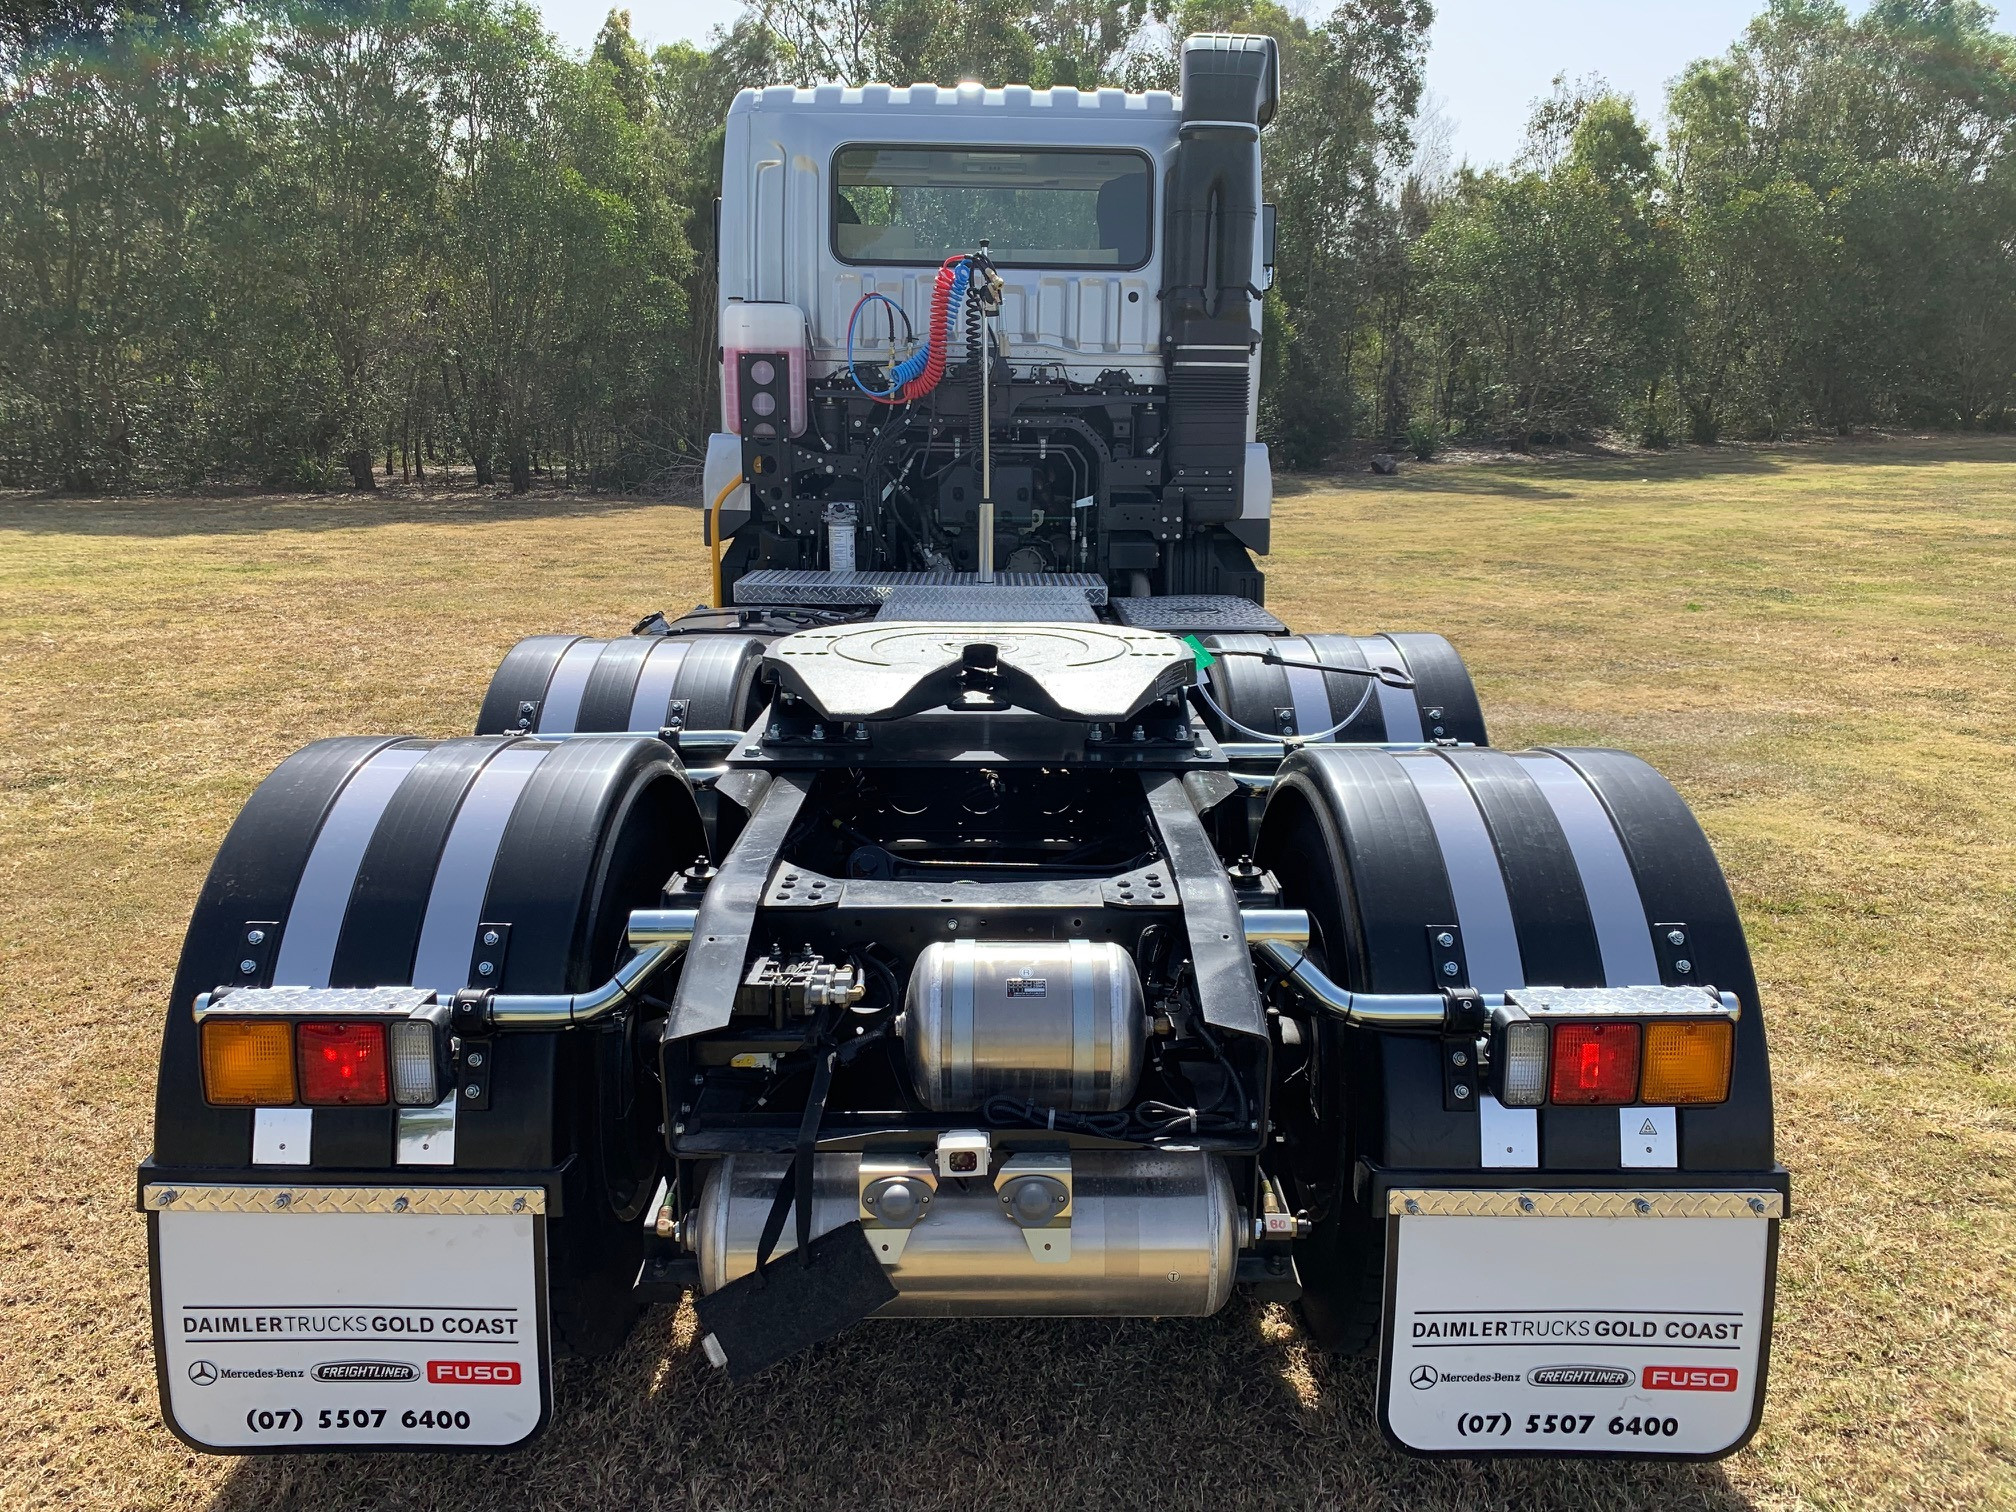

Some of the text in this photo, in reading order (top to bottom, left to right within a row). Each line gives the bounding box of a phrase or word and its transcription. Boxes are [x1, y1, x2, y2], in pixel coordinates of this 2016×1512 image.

[371, 1316, 434, 1333] GOLD
[442, 1318, 518, 1335] COAST
[1594, 1320, 1657, 1337] GOLD
[1665, 1322, 1743, 1340] COAST
[220, 1369, 304, 1379] Mercedes-Benz
[322, 1366, 410, 1379] FREIGHTLINER
[436, 1365, 514, 1381] FUSO
[1440, 1373, 1521, 1383] Mercedes-Benz
[1538, 1370, 1625, 1384] FREIGHTLINER
[1652, 1371, 1730, 1387] FUSO
[246, 1409, 471, 1433] (07) 5507 6400
[1457, 1412, 1679, 1437] (07) 5507 6400
